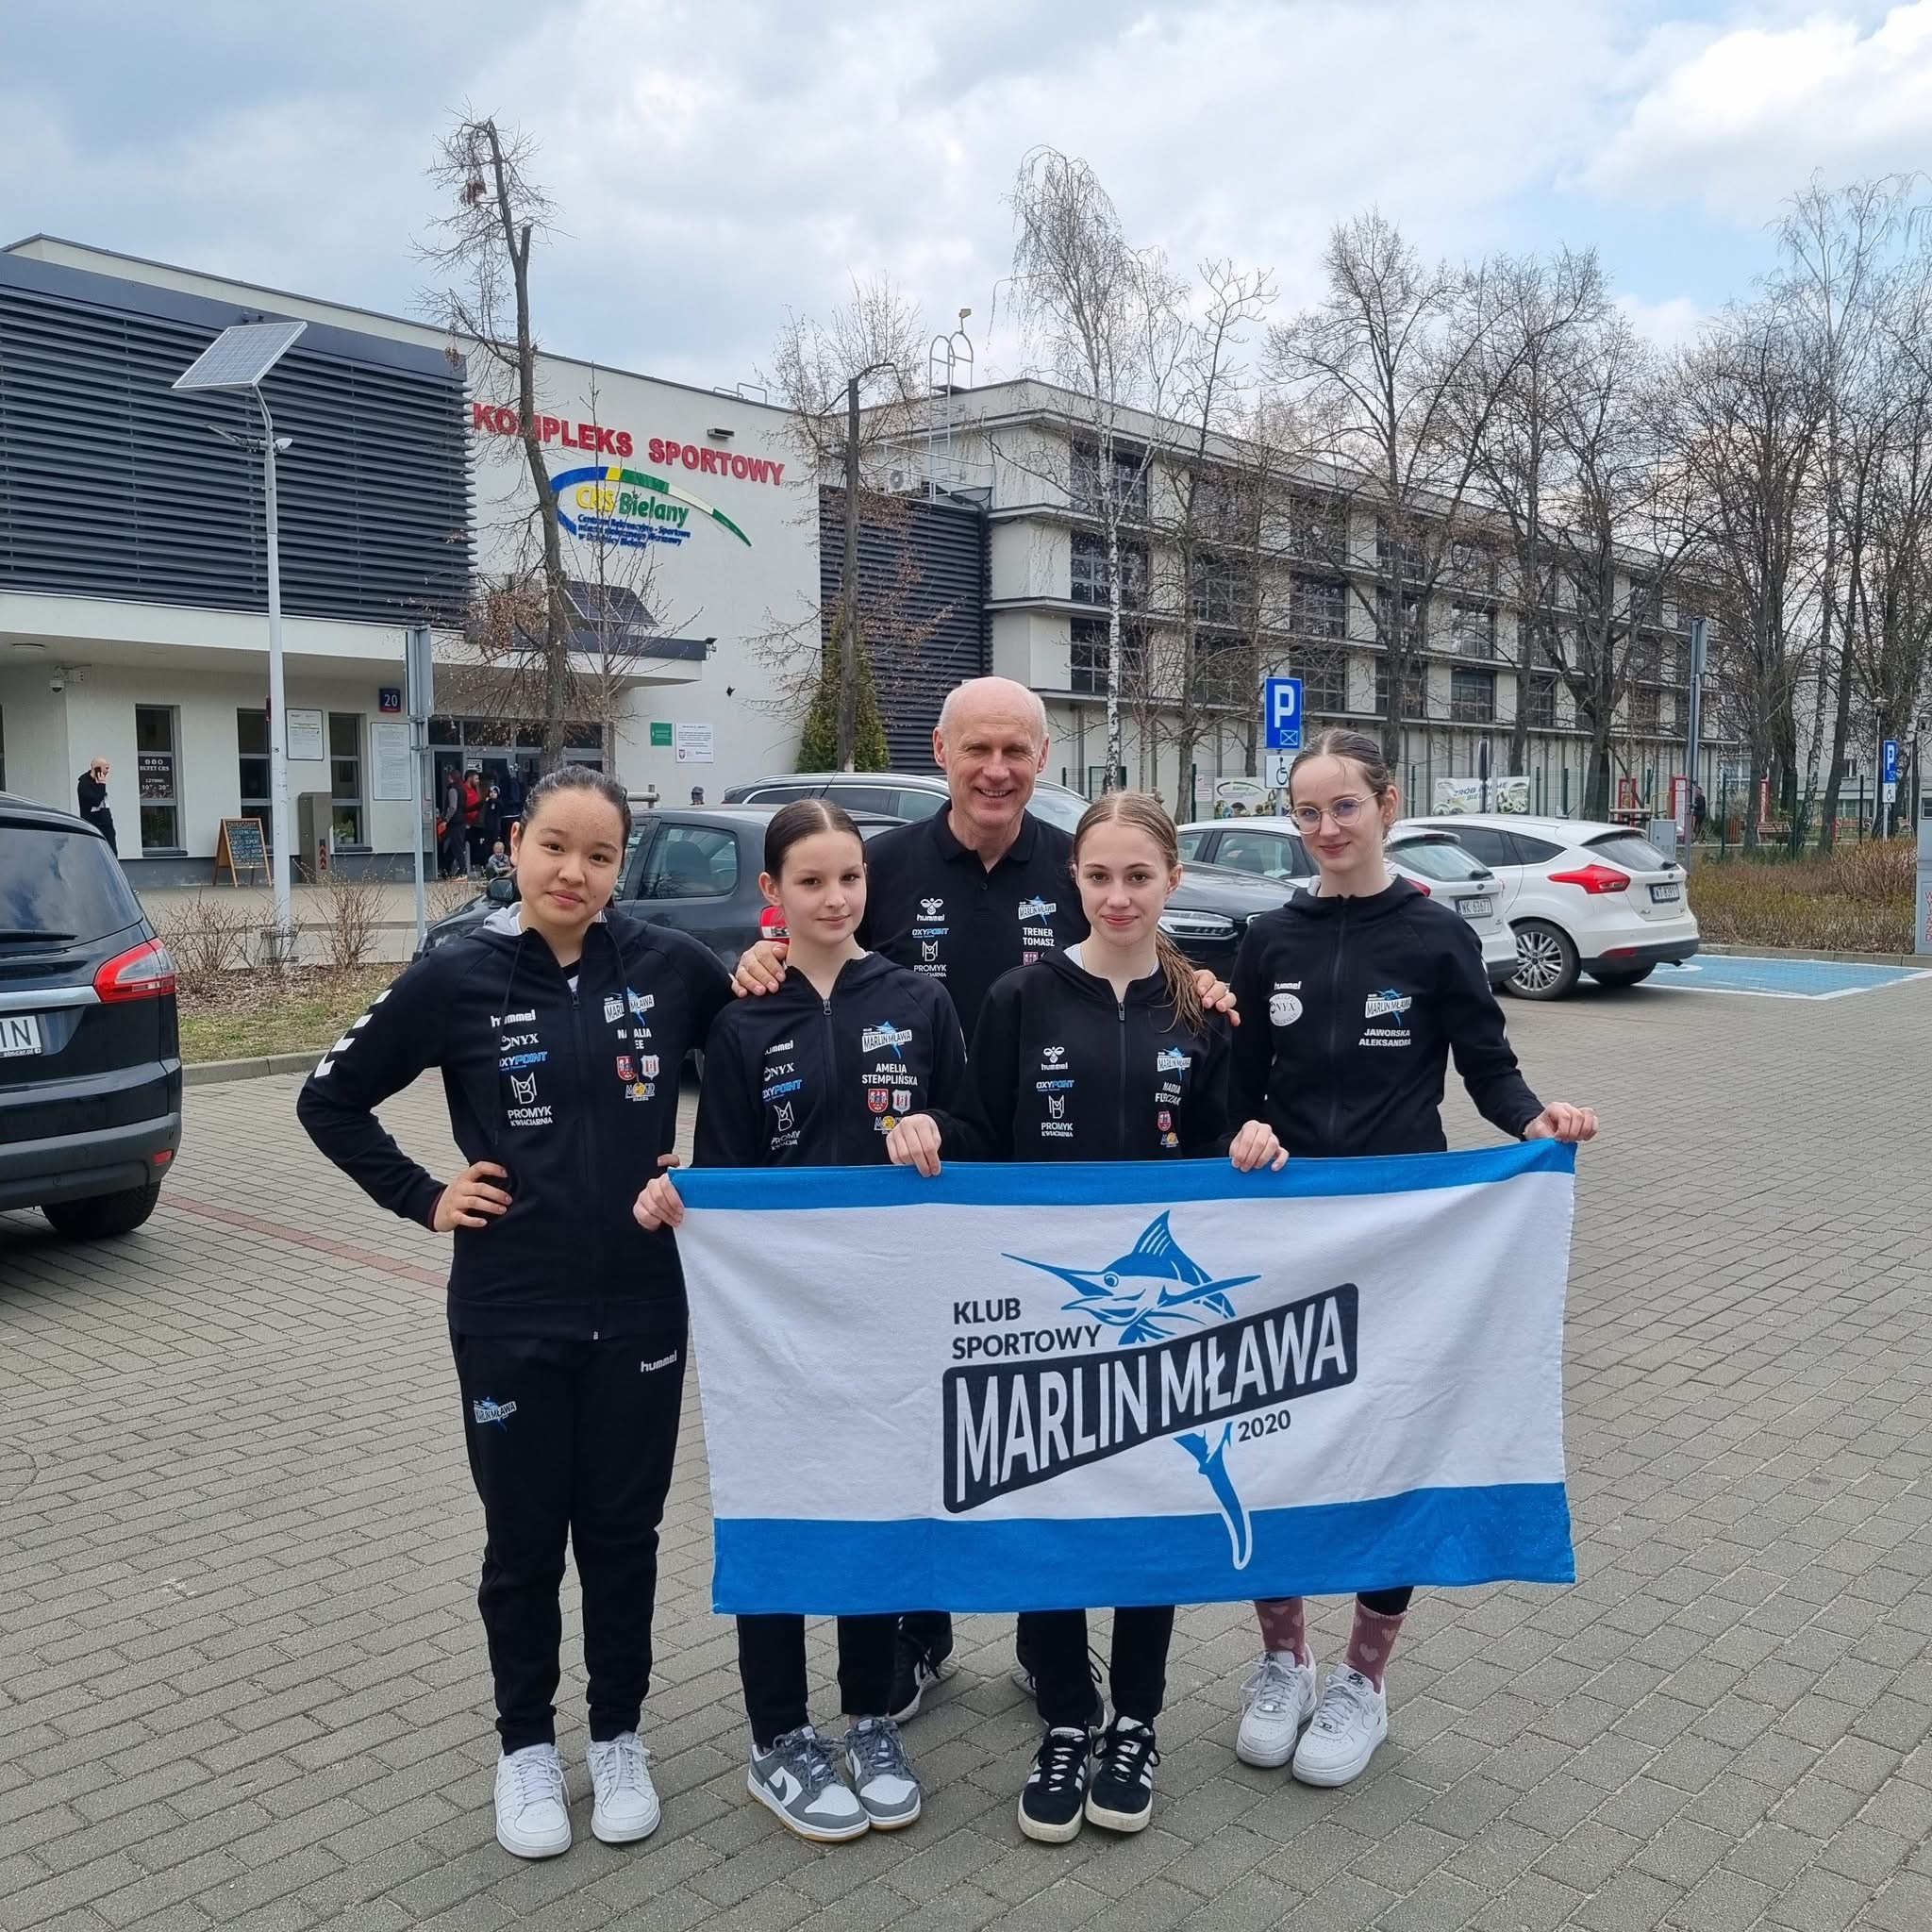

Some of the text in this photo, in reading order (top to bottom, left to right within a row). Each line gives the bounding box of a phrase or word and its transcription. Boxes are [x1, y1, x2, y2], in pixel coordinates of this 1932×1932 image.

[649, 438, 785, 486] SPORTOWY
[619, 492, 690, 528] Bielany
[384, 694, 398, 707] 20
[1274, 685, 1294, 728] P
[1887, 745, 1895, 770] P
[1022, 927, 1054, 937] TRENER
[1022, 937, 1056, 947] TOMASZ
[913, 964, 947, 973] PROMYK
[1367, 1001, 1390, 1016] MARLIN
[1364, 1028, 1410, 1037] JAWORSKA
[764, 1040, 794, 1056] ummel
[863, 1035, 887, 1051] MARLIN
[499, 1052, 548, 1067] XYPOINT
[875, 1063, 907, 1074] AMELIA
[861, 1074, 918, 1086] STEMPLIŃSKA
[508, 1106, 553, 1120] PROMYK
[1041, 1123, 1074, 1131] PROMYK
[771, 1131, 801, 1145] PROMY
[954, 1297, 1021, 1324] KLUB
[952, 1324, 1102, 1359] SPORTOWY
[641, 1350, 677, 1373] hummel
[956, 1296, 1348, 1503] MARLIN MŁAWA
[1238, 1409, 1291, 1442] 2020
